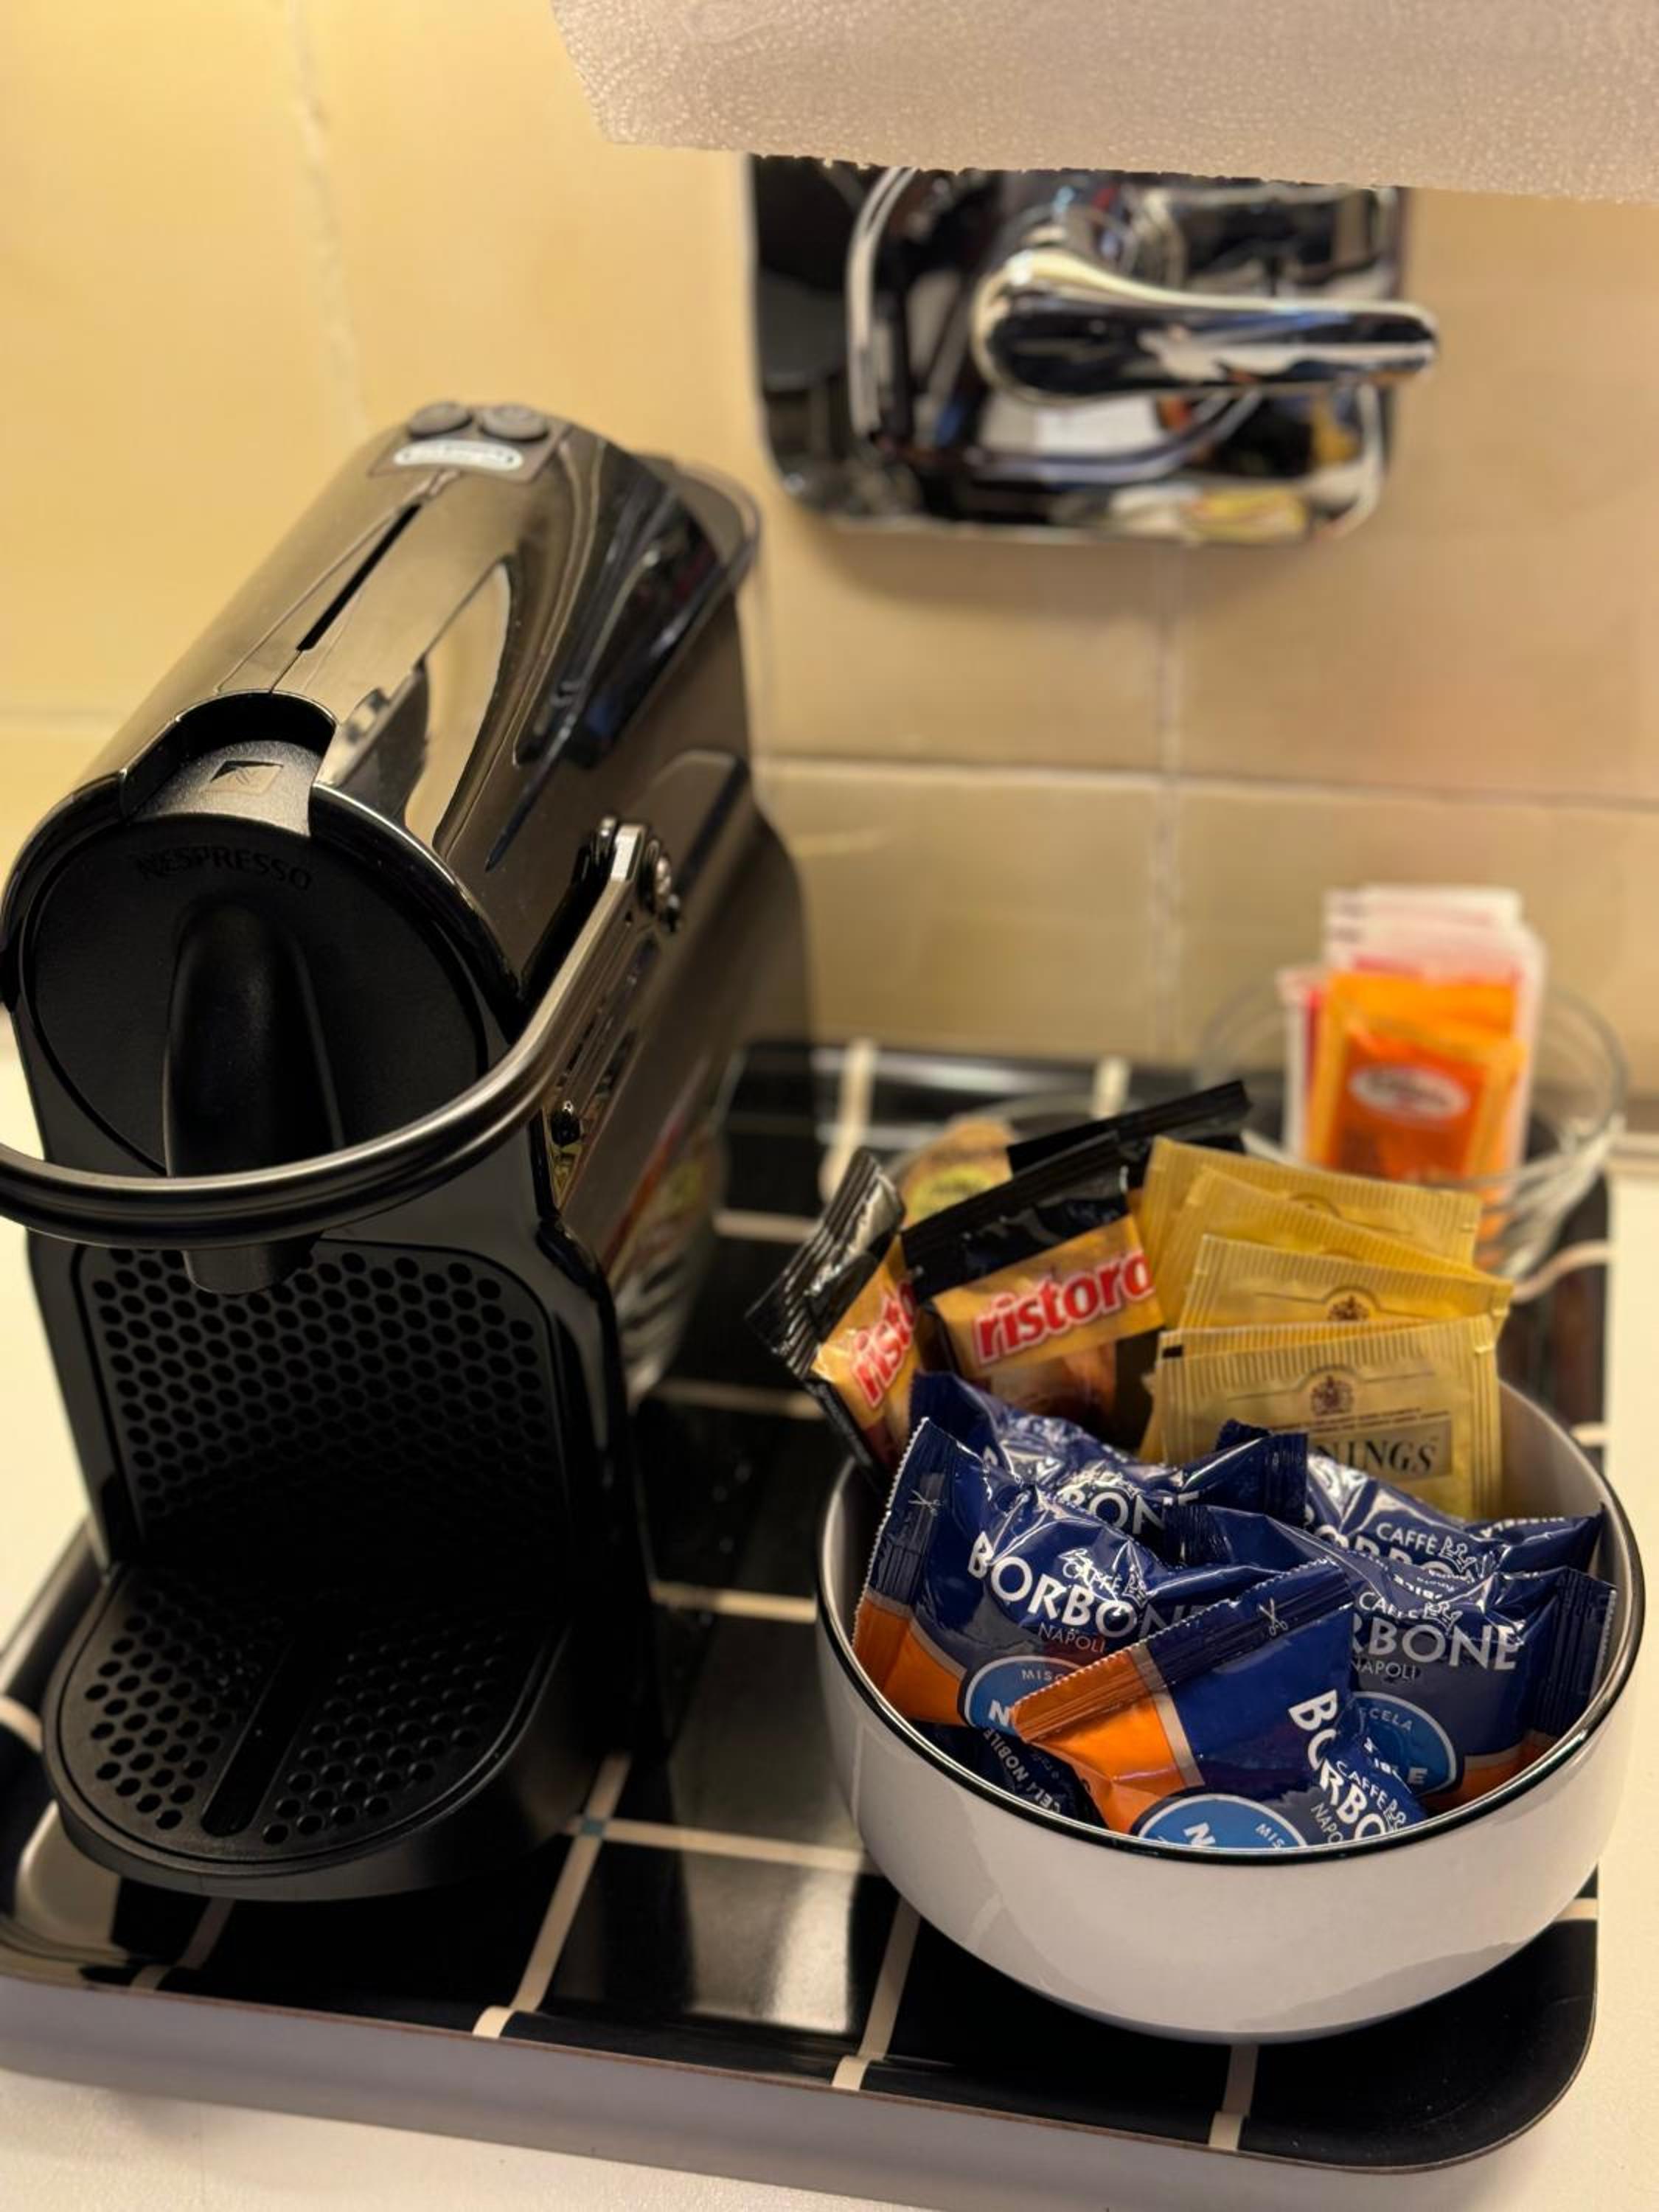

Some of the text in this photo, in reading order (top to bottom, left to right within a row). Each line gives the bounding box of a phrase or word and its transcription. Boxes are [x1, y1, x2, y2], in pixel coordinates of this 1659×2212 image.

[136, 845, 313, 890] NESPRESSO
[1376, 1522, 1438, 1556] CAFFÈ
[1038, 1621, 1106, 1654] NAPOLI
